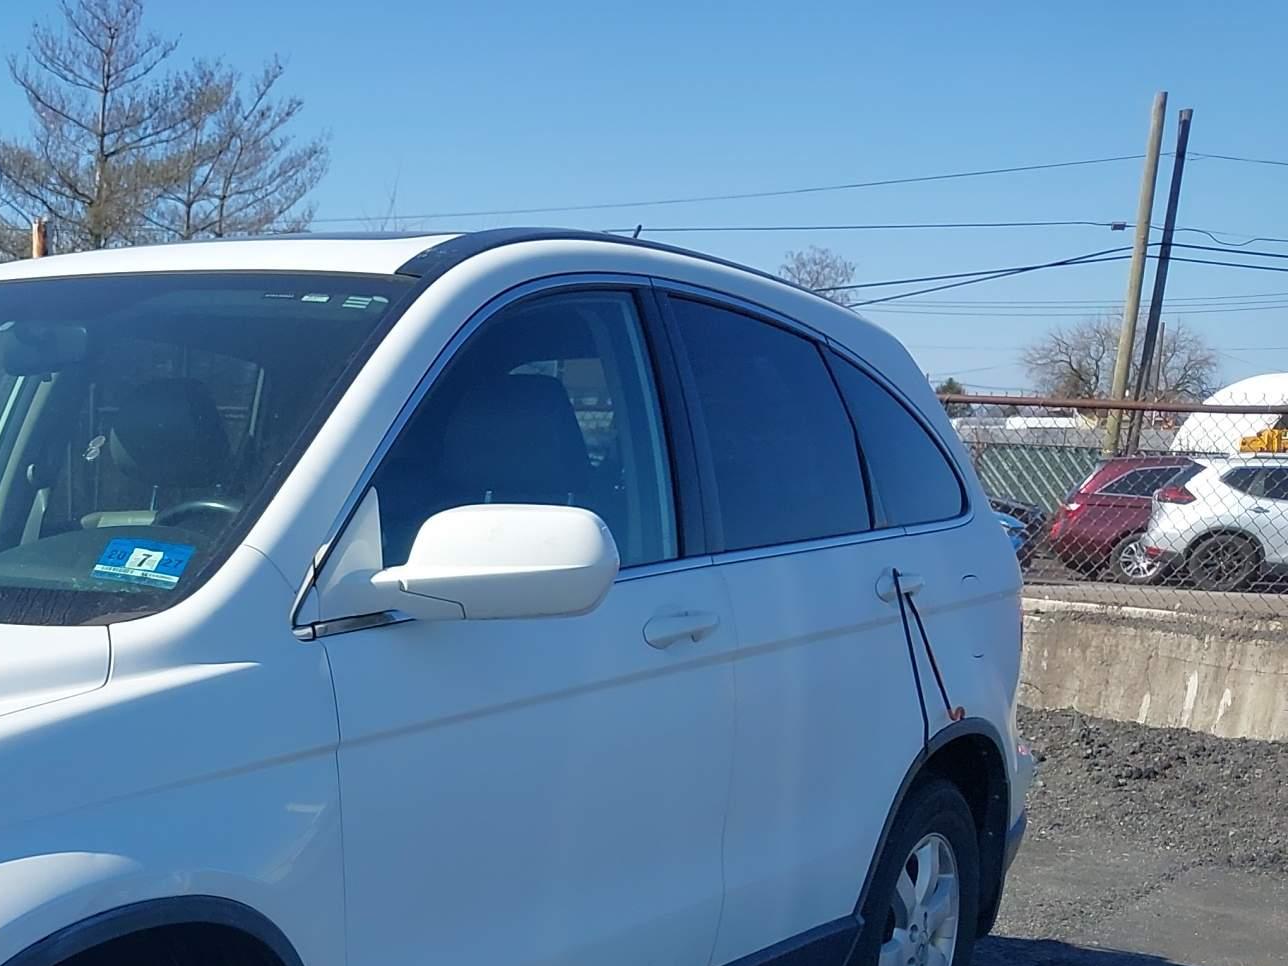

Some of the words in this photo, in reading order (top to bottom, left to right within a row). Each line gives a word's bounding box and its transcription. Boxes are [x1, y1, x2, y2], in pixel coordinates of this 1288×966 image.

[107, 549, 127, 561] 20
[137, 553, 153, 568] 7
[161, 558, 184, 569] 27
